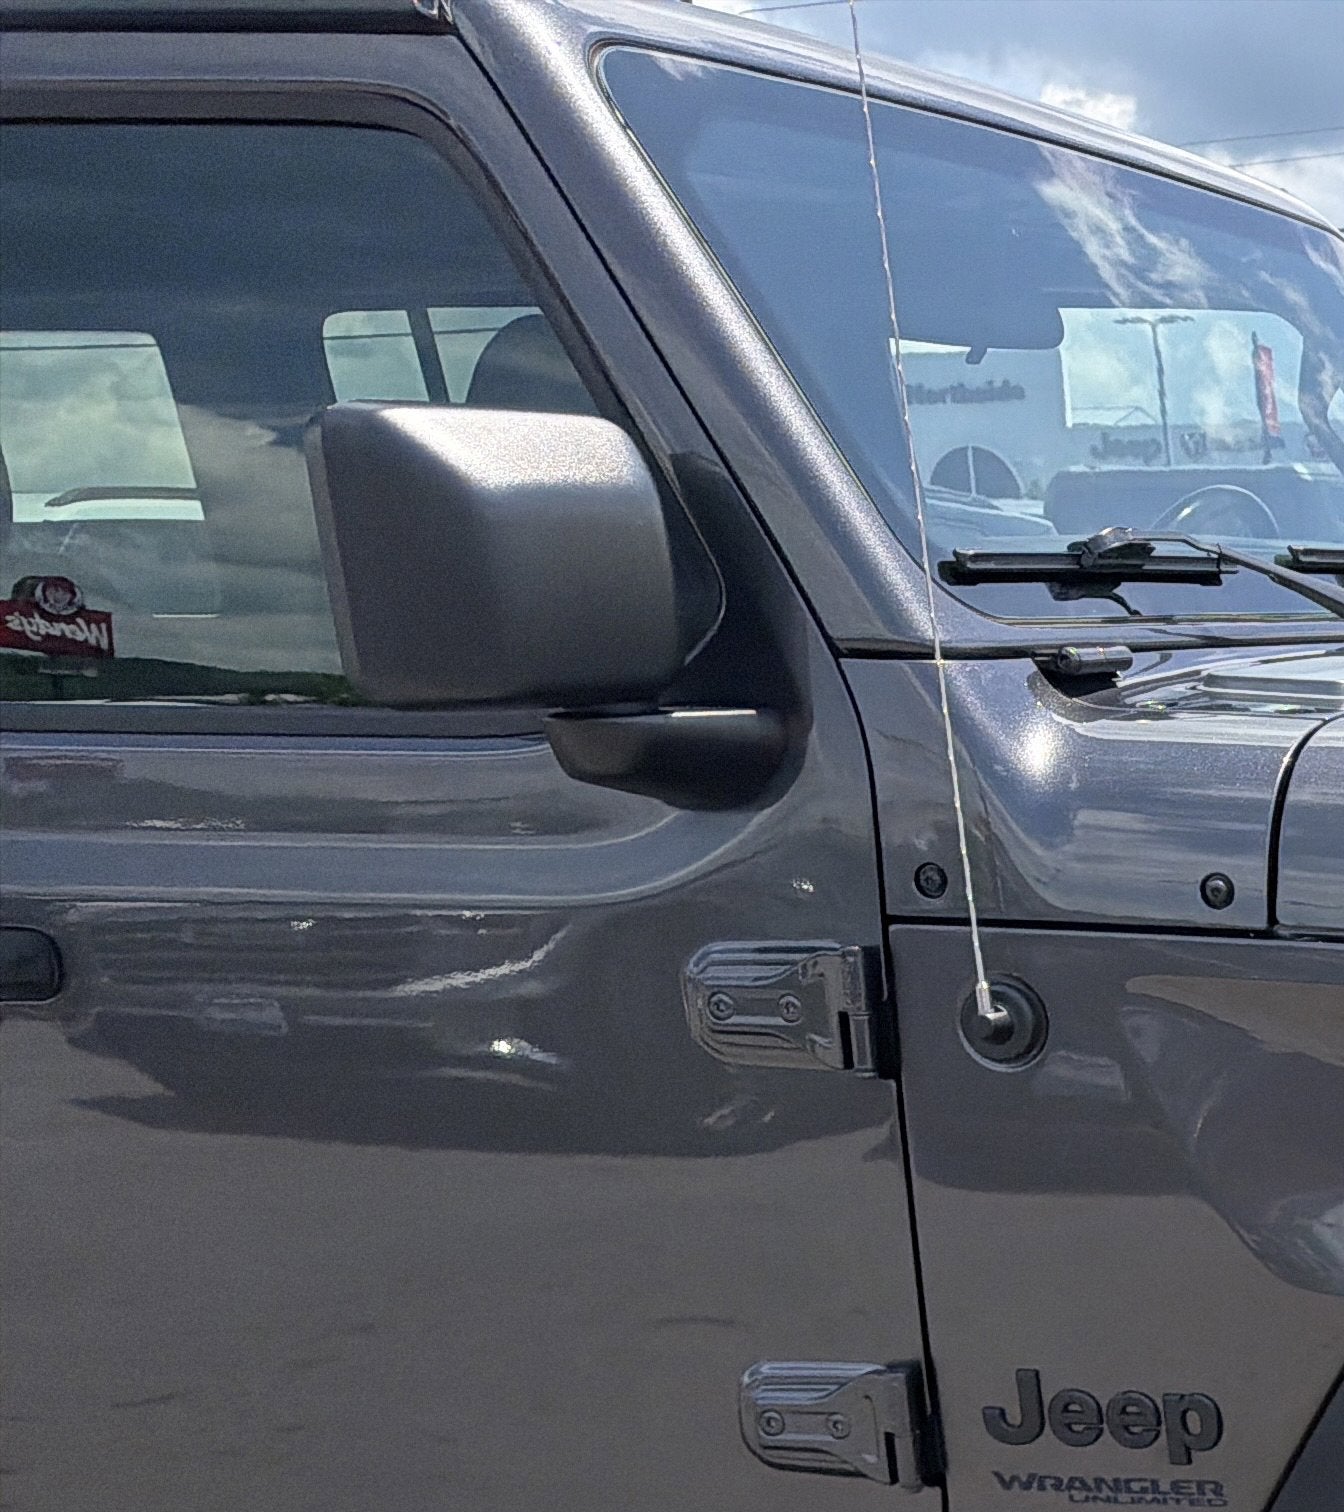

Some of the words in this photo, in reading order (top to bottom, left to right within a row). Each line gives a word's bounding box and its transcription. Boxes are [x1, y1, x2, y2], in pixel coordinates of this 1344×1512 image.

[982, 1367, 1224, 1466] Jeep
[991, 1470, 1225, 1497] WRANGLER
[1067, 1493, 1229, 1508] UNLIMITED
